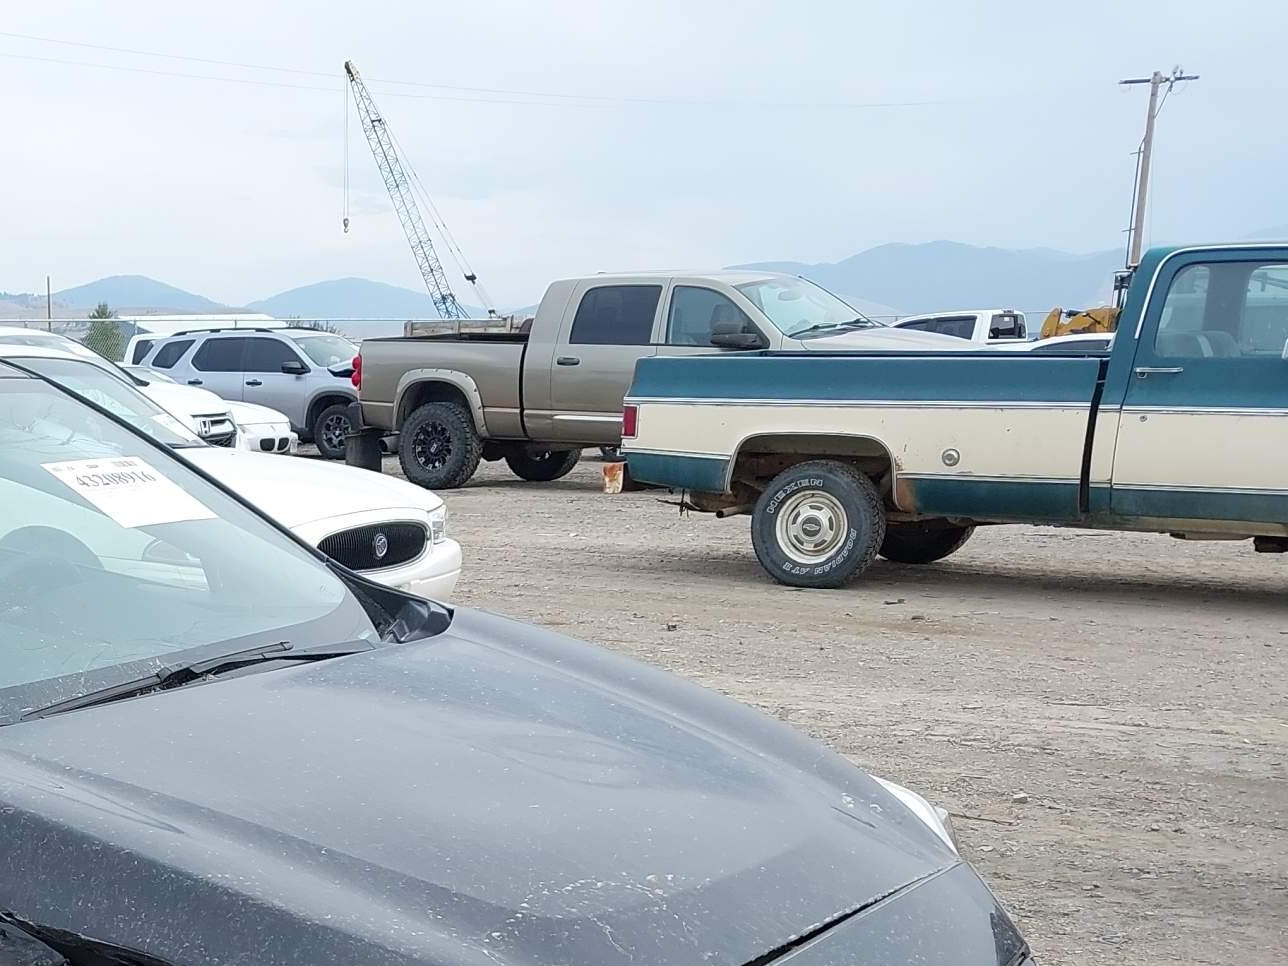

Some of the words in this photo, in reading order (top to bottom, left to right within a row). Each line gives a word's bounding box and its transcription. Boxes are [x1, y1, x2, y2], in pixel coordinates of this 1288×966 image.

[76, 471, 157, 487] 43208916
[767, 478, 823, 514] NEXEN
[814, 528, 857, 575] ROADIAN
